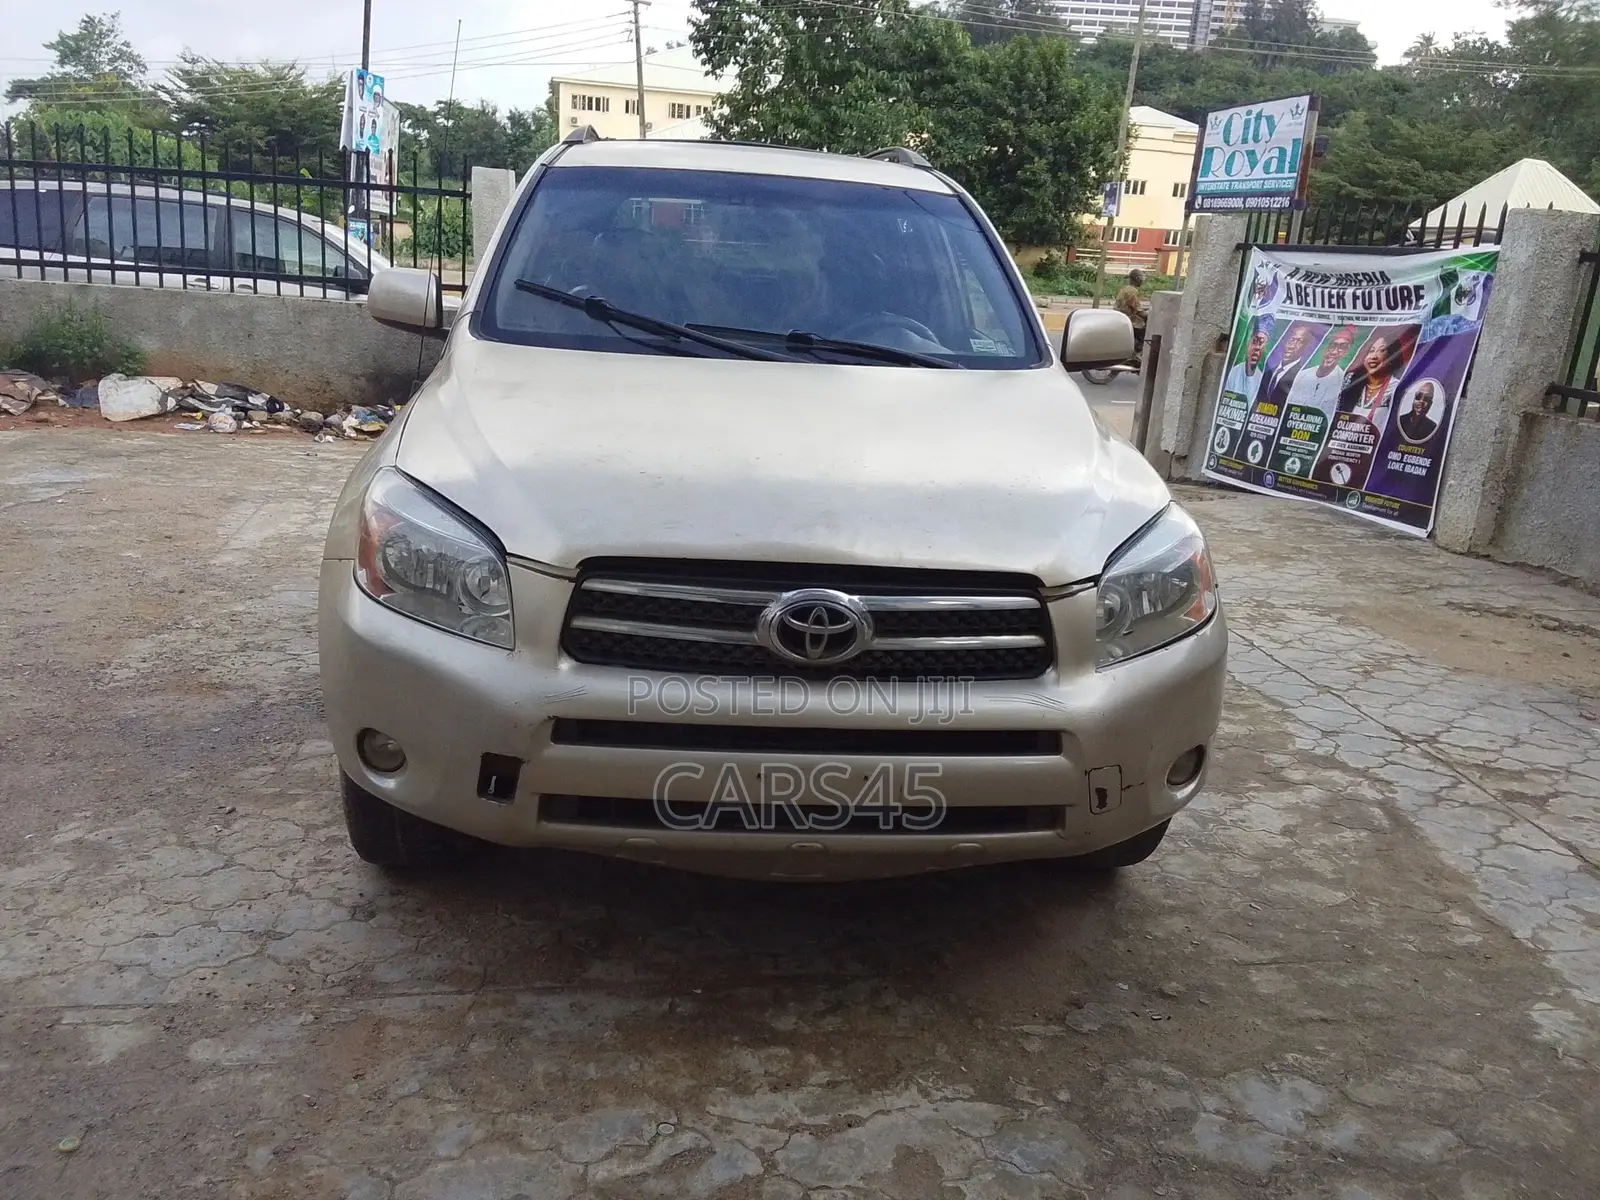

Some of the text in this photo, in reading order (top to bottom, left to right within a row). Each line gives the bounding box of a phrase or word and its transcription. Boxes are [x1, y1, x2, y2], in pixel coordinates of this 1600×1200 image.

[1223, 108, 1284, 147] City
[1199, 138, 1302, 178] Royal
[1230, 180, 1262, 190] TRANSPORT
[1282, 282, 1427, 311] A BETTER FUTURE
[1286, 420, 1321, 433] OYEKUNLE
[1291, 429, 1311, 441] DON
[1332, 429, 1375, 444] COMFORTER
[1387, 451, 1402, 461] OMO
[1387, 461, 1427, 477] LOKE IBADAN
